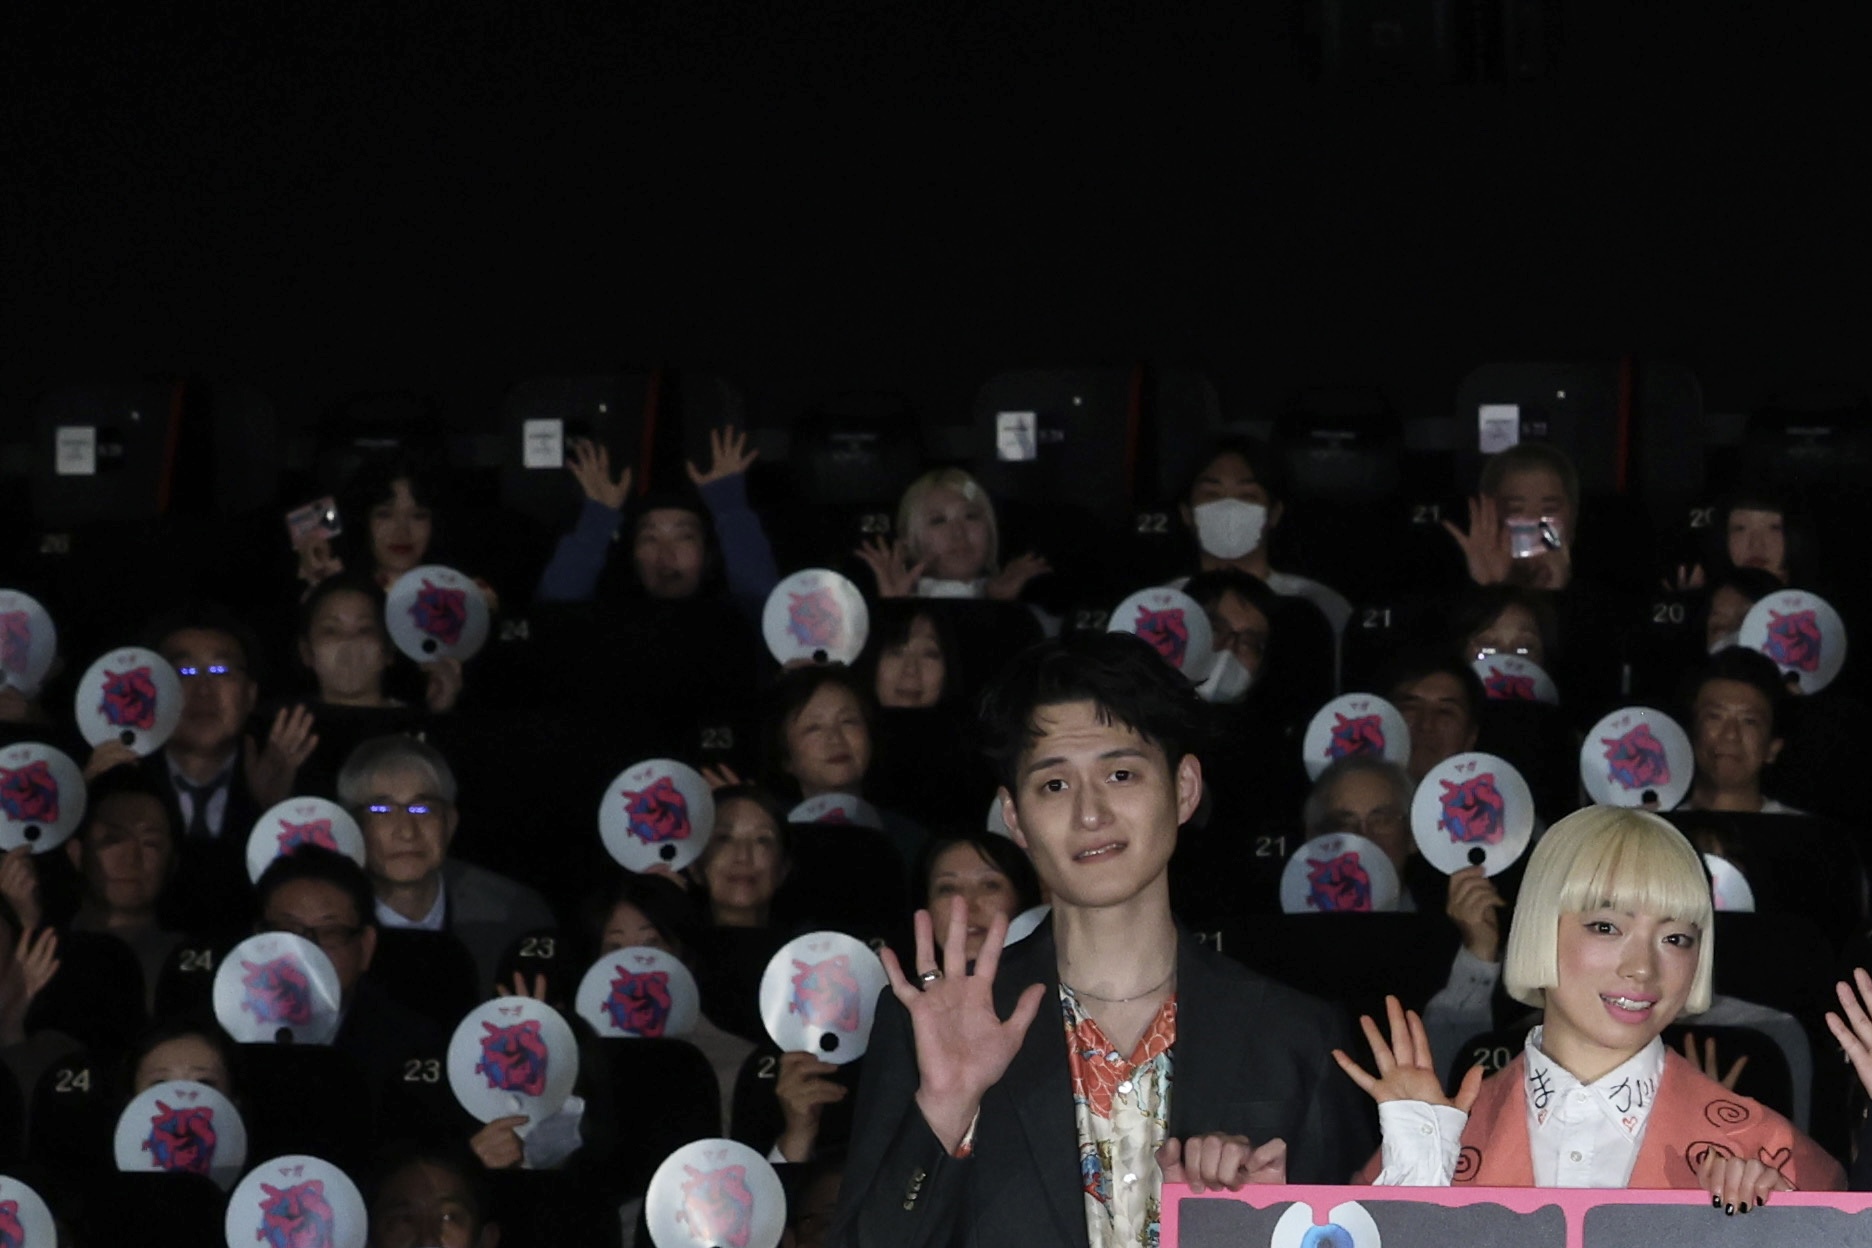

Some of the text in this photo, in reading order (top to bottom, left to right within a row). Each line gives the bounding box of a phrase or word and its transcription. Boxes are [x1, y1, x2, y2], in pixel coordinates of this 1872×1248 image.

[1254, 835, 1286, 858] 21
[518, 937, 556, 960] 23
[178, 949, 214, 972] 24
[757, 1055, 776, 1079] 2
[1472, 1047, 1511, 1070] 20
[54, 1068, 91, 1093] 24
[403, 1058, 441, 1084] 23
[1530, 1068, 1555, 1109] ま
